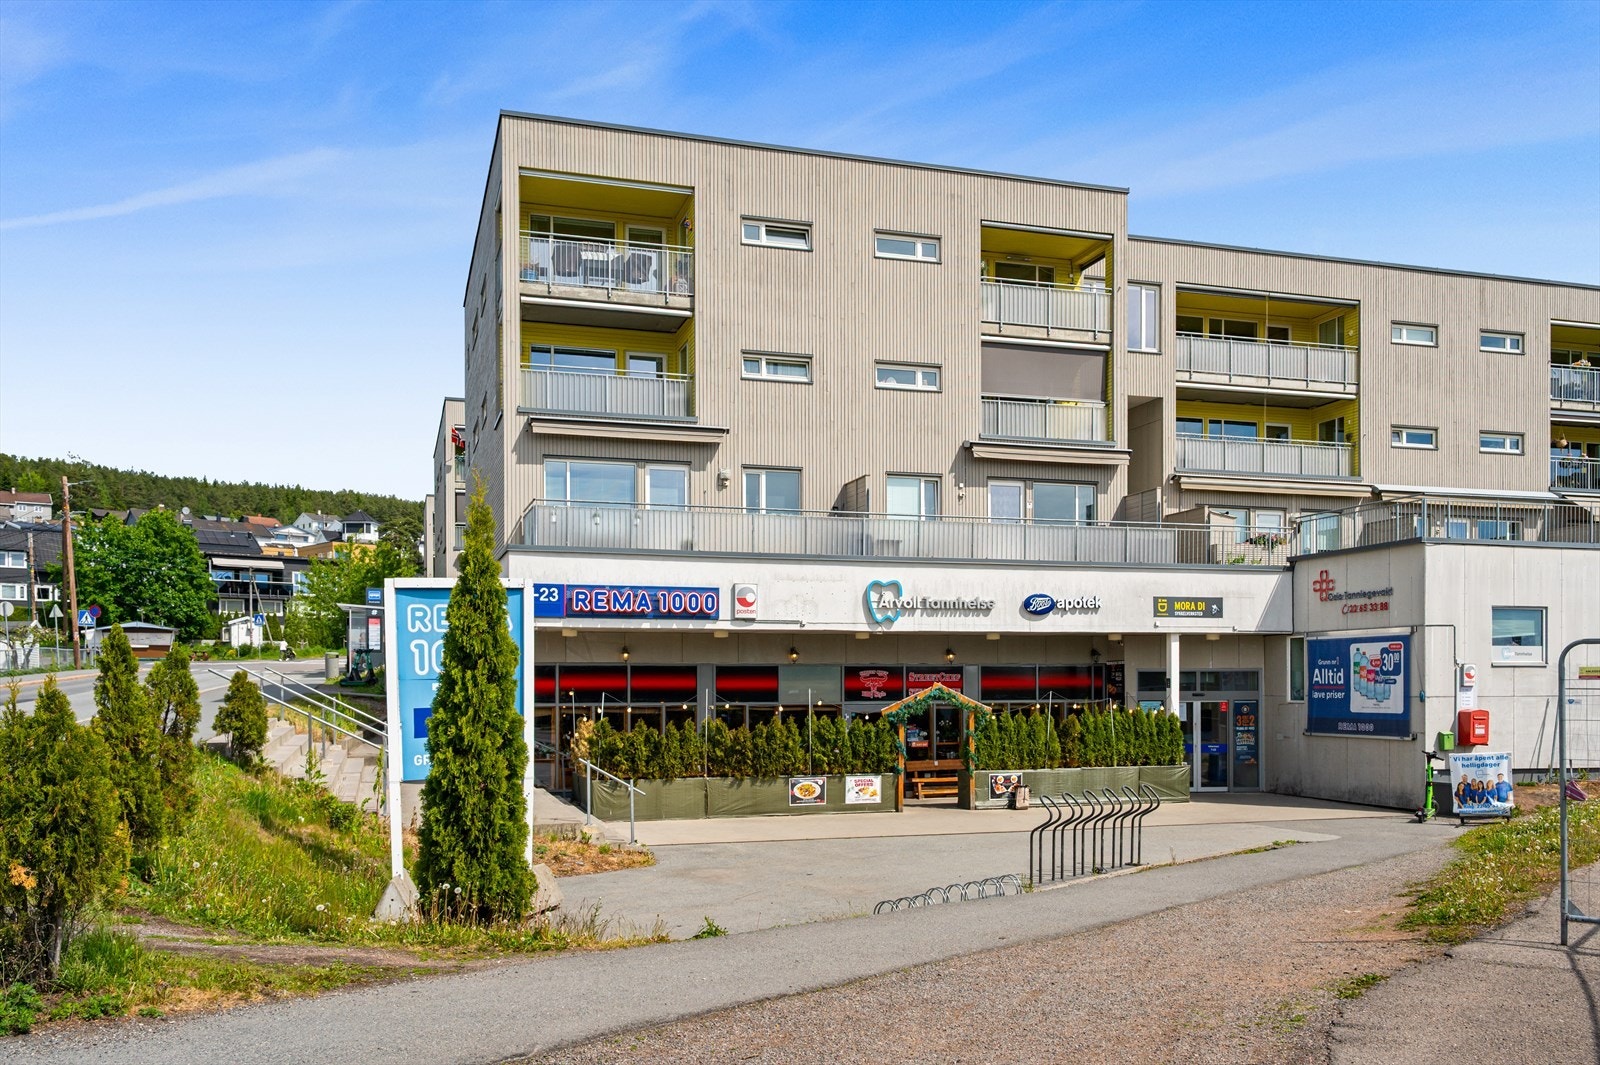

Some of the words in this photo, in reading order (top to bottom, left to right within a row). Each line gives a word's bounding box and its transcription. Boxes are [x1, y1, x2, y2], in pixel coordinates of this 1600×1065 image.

[573, 589, 652, 613] REMA
[658, 592, 717, 613] 1000
[1056, 596, 1102, 611] apotek
[1174, 601, 1196, 611] MORA
[1197, 602, 1206, 611] DI
[1382, 653, 1394, 671] 30
[1312, 668, 1344, 685] Alltid
[1326, 689, 1345, 700] priser
